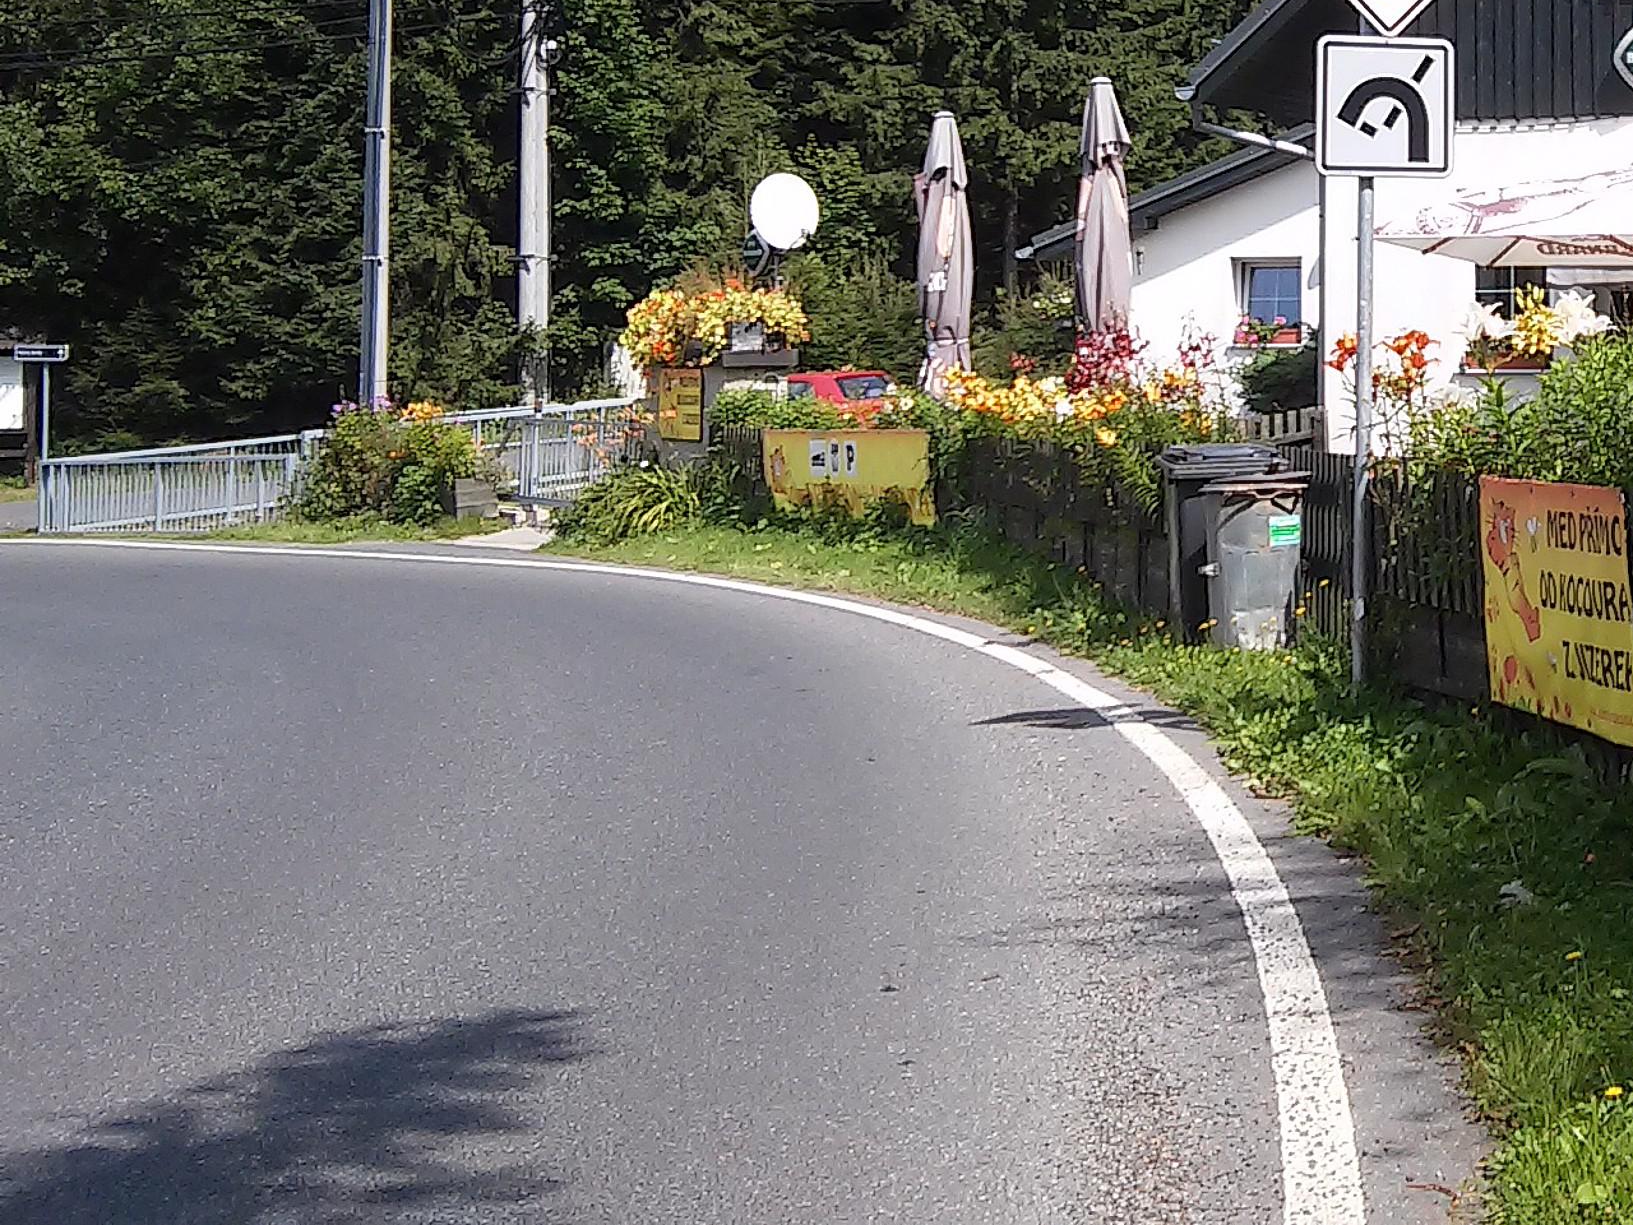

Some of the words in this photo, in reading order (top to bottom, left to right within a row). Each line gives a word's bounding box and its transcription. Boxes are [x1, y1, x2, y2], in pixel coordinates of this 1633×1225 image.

[1547, 509, 1577, 551] MED
[1540, 569, 1558, 609] OD
[1559, 573, 1633, 623] KOCOURA
